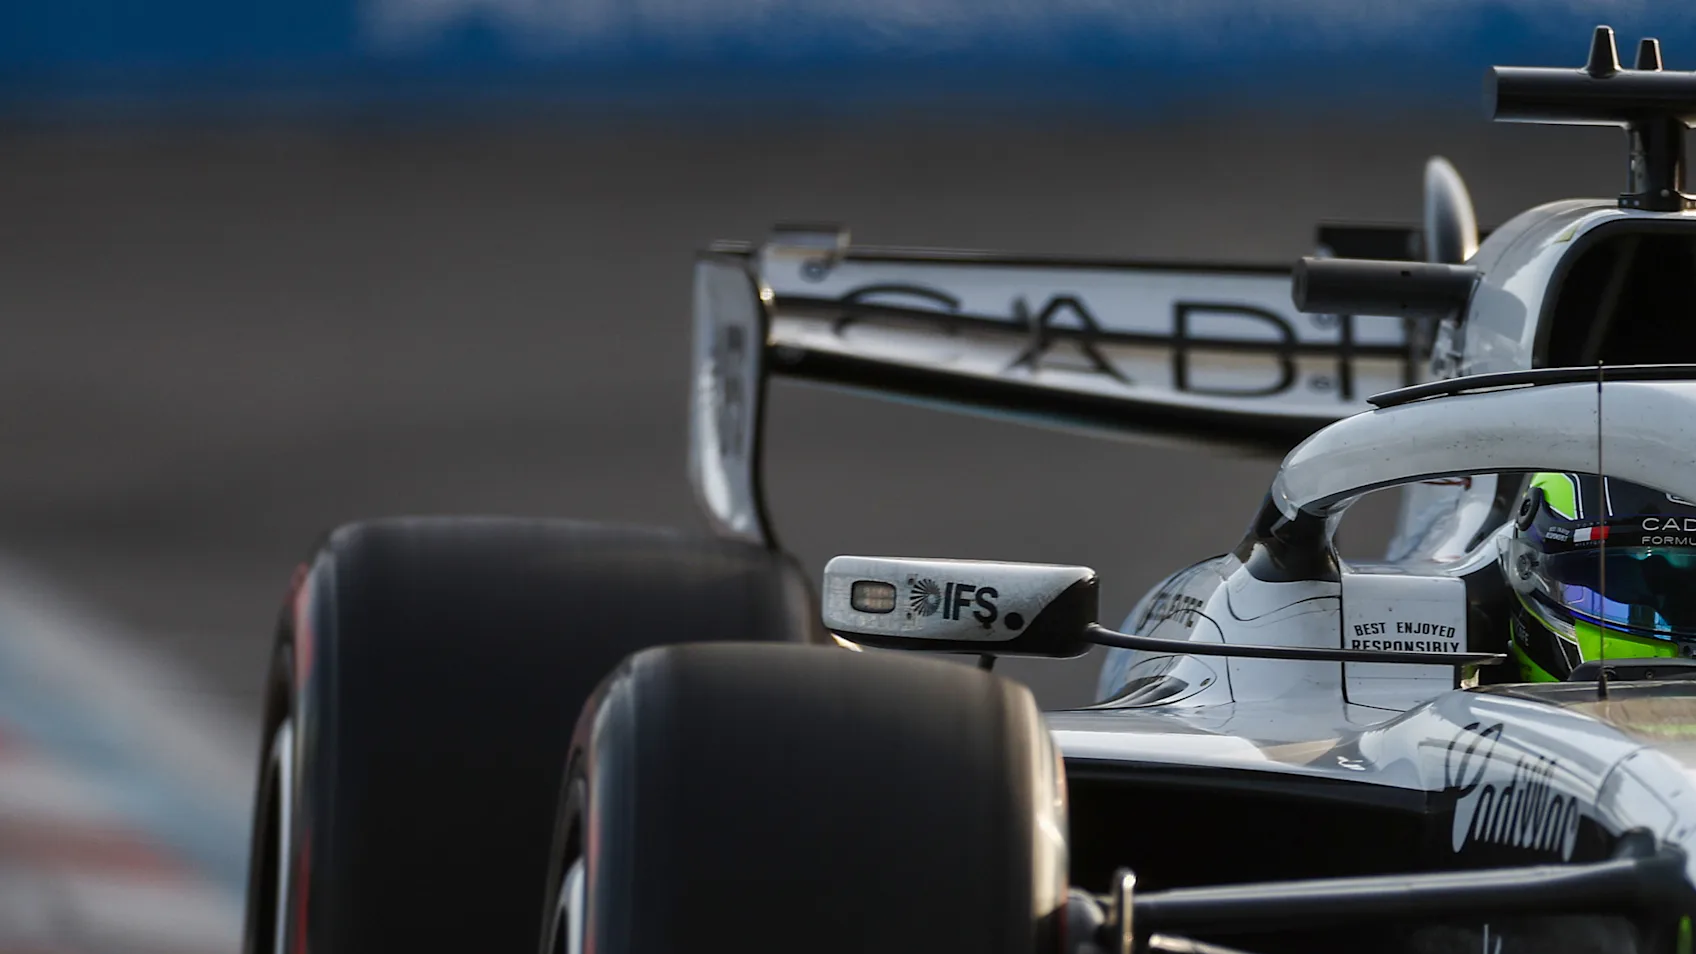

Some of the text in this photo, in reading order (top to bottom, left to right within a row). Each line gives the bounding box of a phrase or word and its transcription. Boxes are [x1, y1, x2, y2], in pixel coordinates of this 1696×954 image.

[943, 582, 998, 623] IFS
[1353, 621, 1456, 639] BEST ENJOYED
